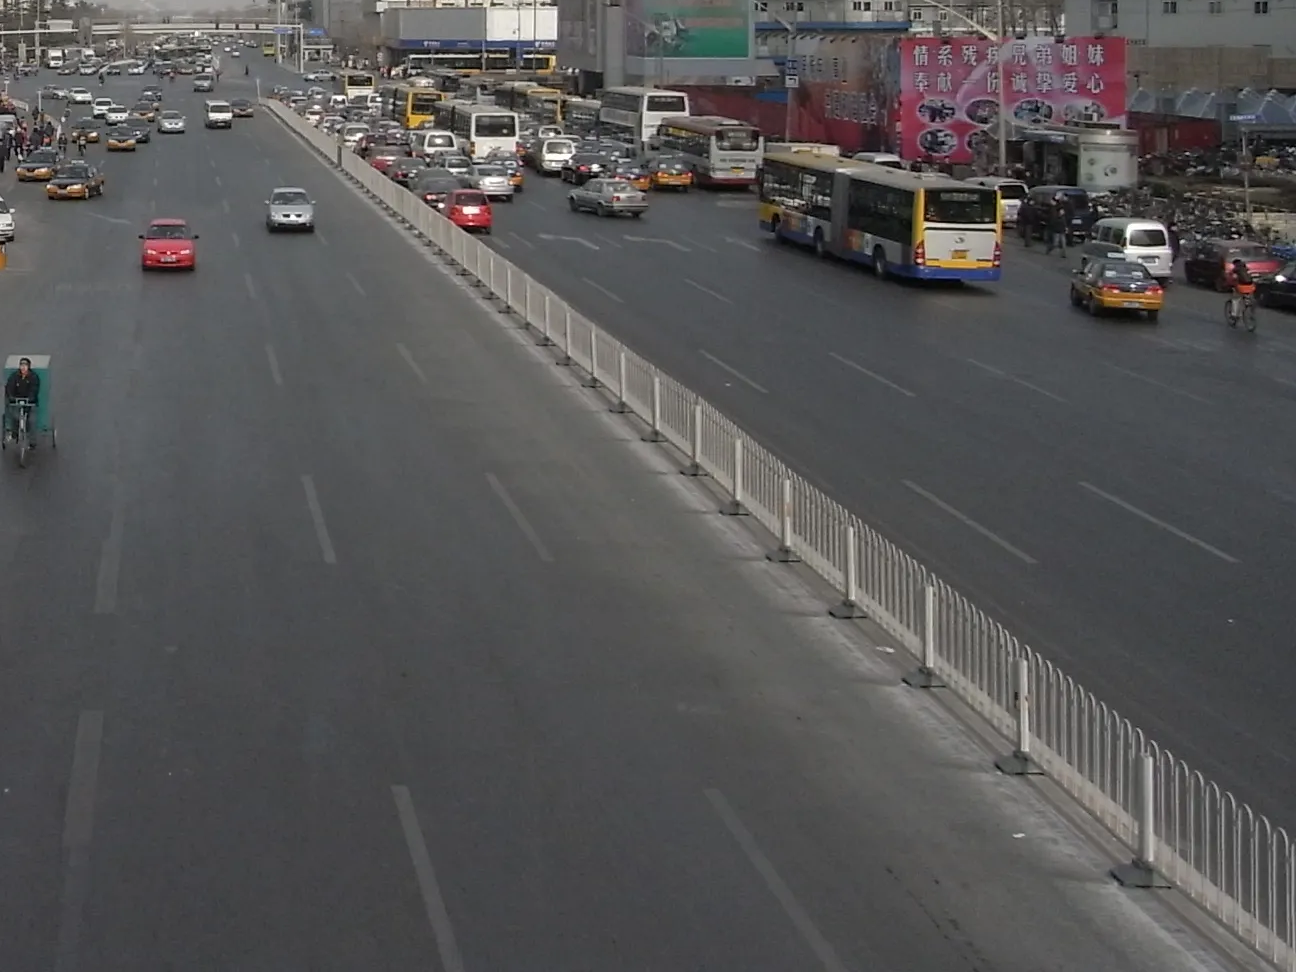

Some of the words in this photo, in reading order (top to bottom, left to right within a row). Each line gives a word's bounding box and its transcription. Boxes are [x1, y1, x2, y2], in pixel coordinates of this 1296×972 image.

[913, 44, 1104, 66] 情系残疾兄弟姐妹
